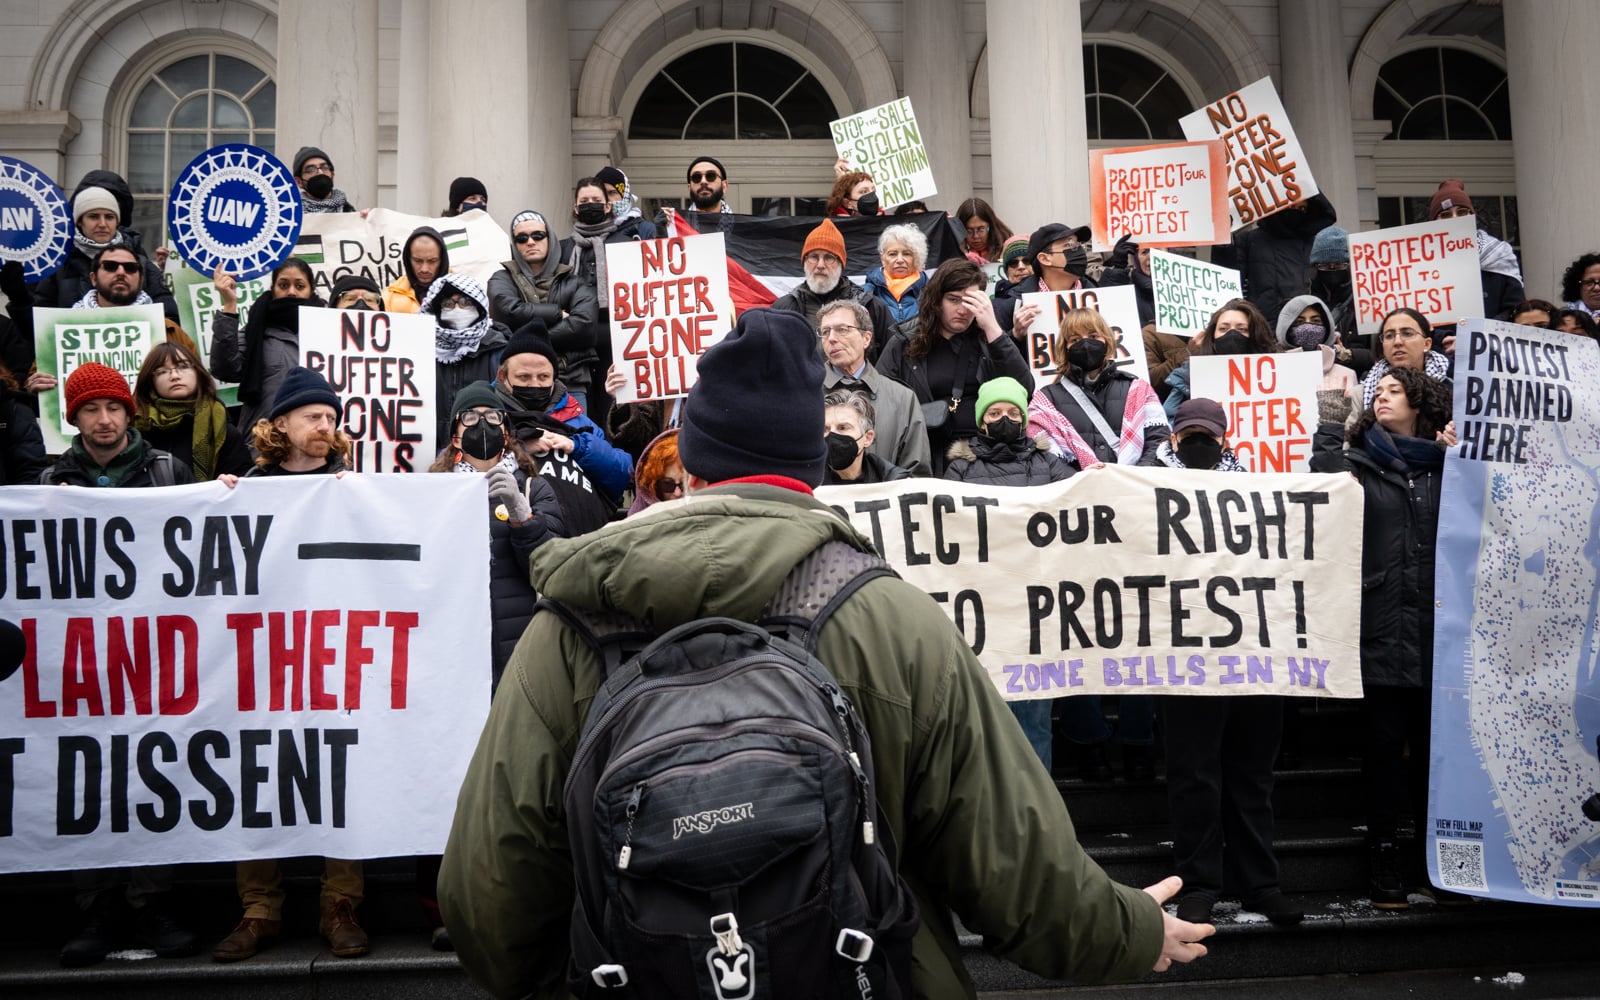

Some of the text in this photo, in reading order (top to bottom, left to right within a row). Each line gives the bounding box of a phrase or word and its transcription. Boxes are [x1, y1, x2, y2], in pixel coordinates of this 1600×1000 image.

[832, 116, 864, 145] STOP
[878, 99, 914, 130] SALE
[1206, 92, 1247, 134] NO
[842, 121, 921, 164] OF STOLEN
[1221, 113, 1281, 161] FFER
[845, 145, 929, 186] ESTINIAN
[1109, 163, 1206, 192] PROTECT OUR
[1230, 138, 1296, 193] ONE
[208, 196, 260, 228] UAW
[880, 178, 914, 208] AND
[1109, 189, 1178, 215] RIGHT TO
[1233, 171, 1302, 223] BILLS
[0, 207, 33, 231] AW
[1111, 210, 1189, 238] PROTEST
[340, 236, 401, 264] DJs
[641, 236, 686, 278] NO
[1352, 232, 1474, 271] PROTECT OUR
[1154, 256, 1239, 292] PROTECT OUR
[1156, 281, 1217, 308] RIGHT TO
[1356, 265, 1440, 298] RIGHT TO
[614, 277, 714, 321] BUFFER
[1159, 304, 1212, 330] PROTE
[61, 325, 141, 350] STOP
[341, 312, 391, 353] NO
[621, 314, 718, 361] ZONE
[634, 355, 697, 399] BILL
[1228, 356, 1276, 396] NO
[1468, 332, 1571, 381] PROTEST
[340, 396, 423, 443] ONE
[1465, 376, 1573, 423] BANNED
[1459, 421, 1531, 464] HERE
[539, 461, 593, 494] AME
[832, 487, 1330, 566] TECT OUR RIGHT
[0, 515, 273, 600] EWS SAY
[930, 589, 985, 656] O
[21, 609, 419, 718] LAND THEFT
[1003, 655, 1331, 693] ZONE BILLS IN NY
[57, 728, 358, 836] DISSENT
[673, 803, 753, 839] JANSPORT
[1436, 818, 1483, 832] VIEW FULL MAP
